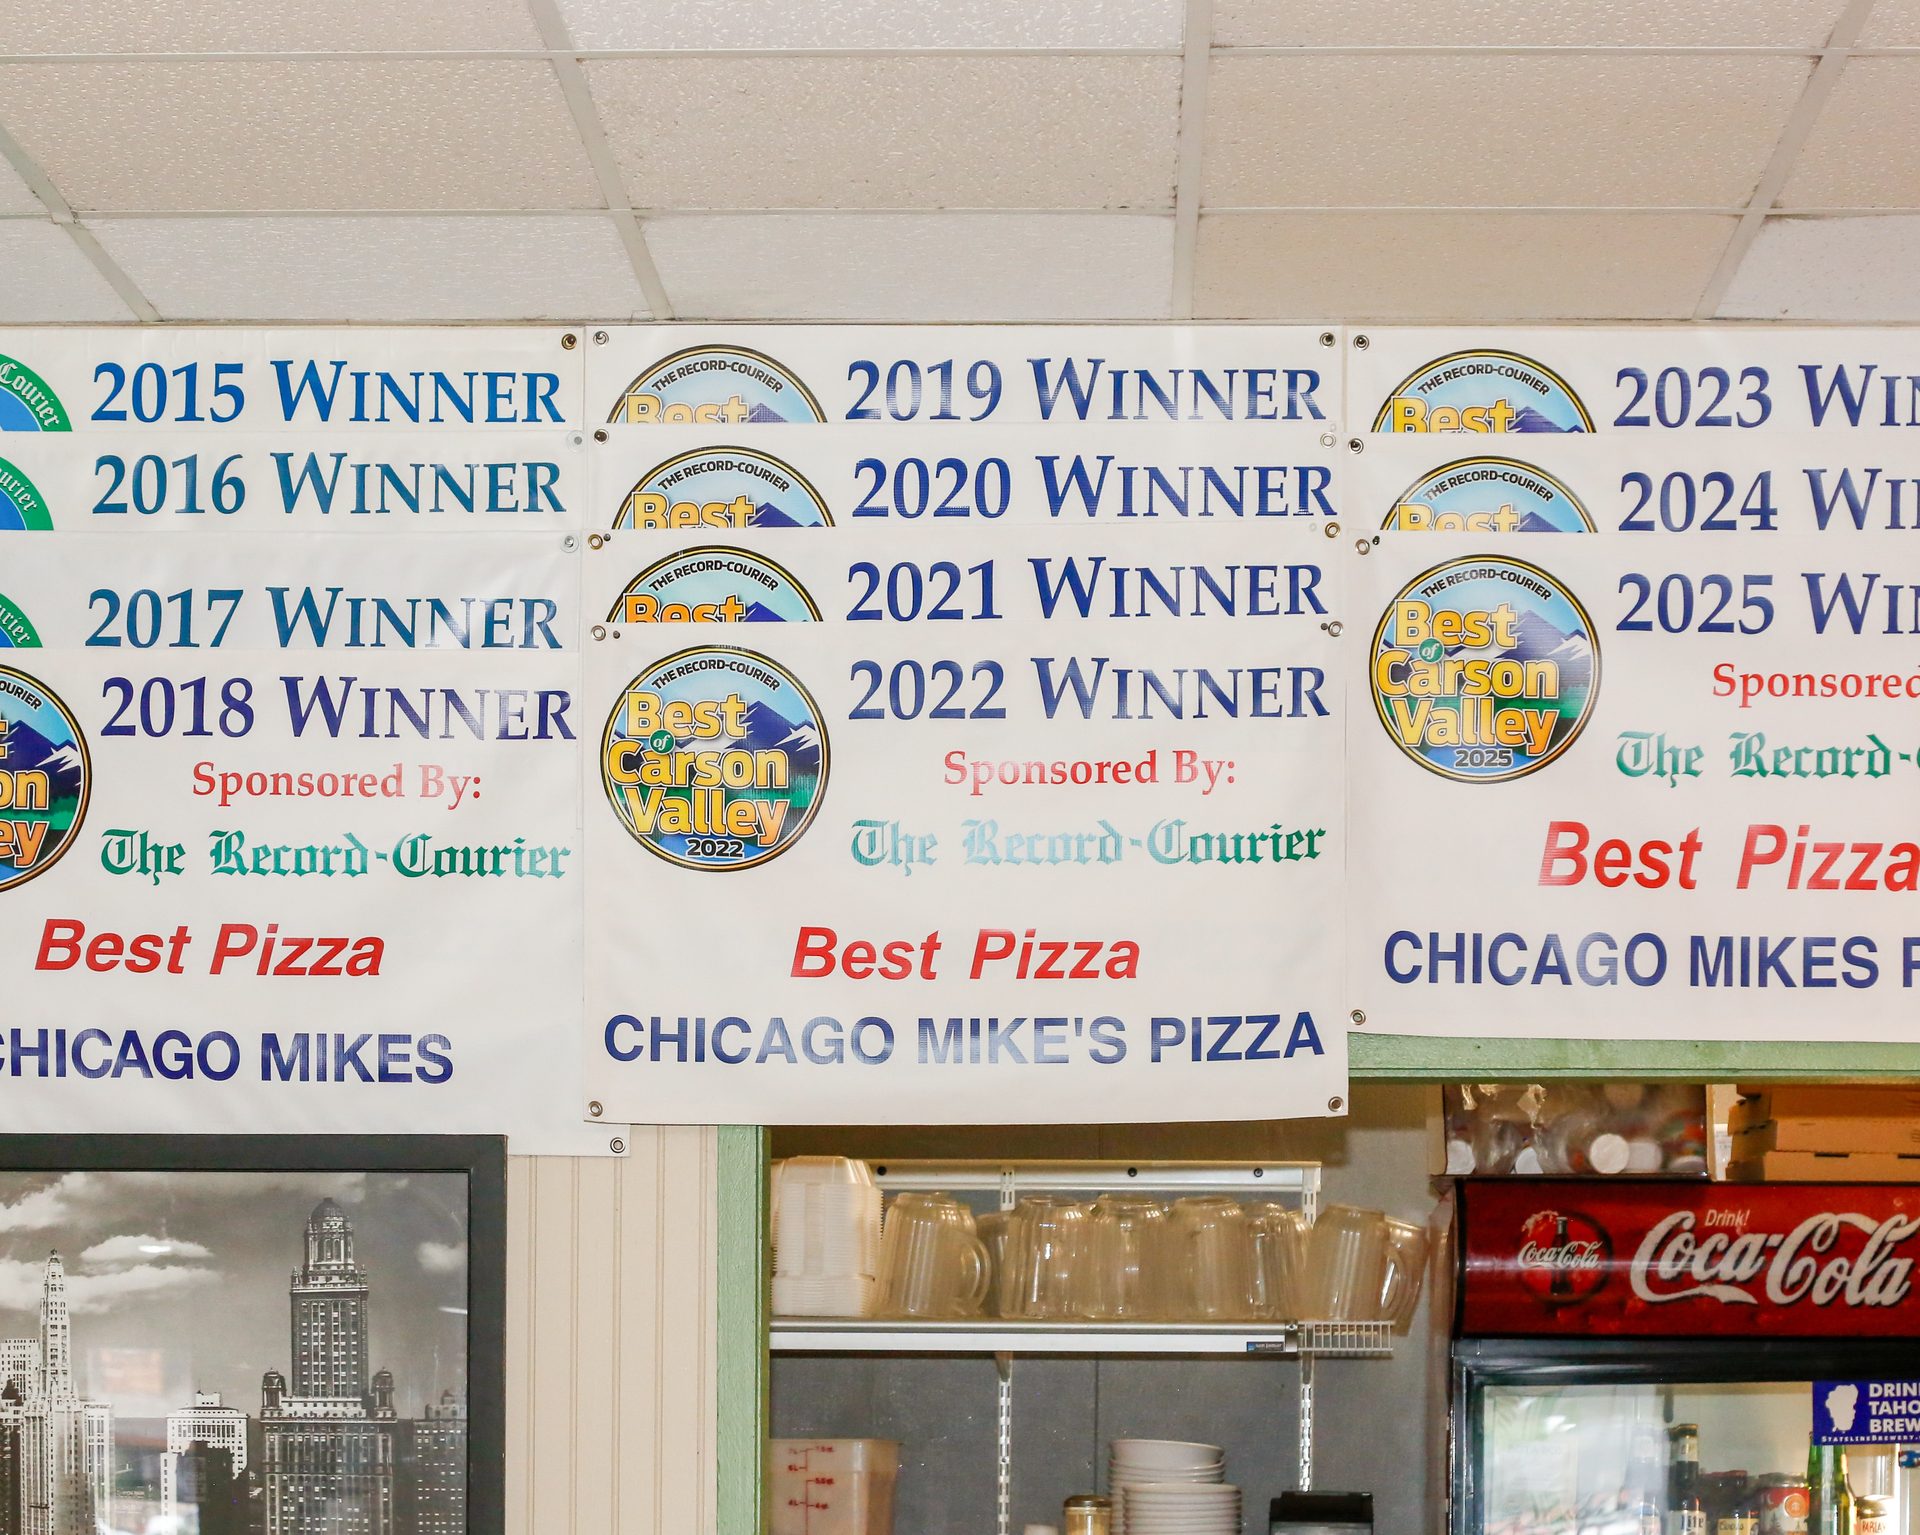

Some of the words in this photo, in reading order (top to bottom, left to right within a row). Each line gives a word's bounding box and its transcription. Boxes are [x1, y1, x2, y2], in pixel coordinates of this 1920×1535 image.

[91, 362, 245, 423] 2015
[270, 359, 566, 423] WINNER
[651, 371, 678, 392] THE
[678, 360, 784, 393] RECORD-COURIER
[845, 359, 1002, 421] 2019
[1027, 357, 1326, 420] WINNER
[1417, 374, 1444, 395] THE
[1443, 363, 1550, 396] RECORD-COURIER
[1613, 366, 1772, 428] 2023
[92, 454, 245, 515] 2016
[270, 452, 567, 514] WINNER
[657, 471, 684, 491] THE
[684, 460, 791, 493] RECORD-COURIER
[852, 458, 1011, 519] 2020
[1035, 455, 1338, 517] WINNER
[1422, 481, 1449, 501] THE
[1448, 470, 1554, 502] RECORD-COURIER
[1619, 471, 1778, 532] 2024
[1802, 468, 1920, 531] WI
[649, 572, 675, 592] THE
[673, 560, 779, 592] RECORD-COURIER
[846, 559, 1003, 621] 2021
[1027, 557, 1328, 619] WINNER
[1420, 579, 1447, 598] THE
[1445, 568, 1552, 601] RECORD-COURIER
[85, 588, 244, 648] 2017
[265, 586, 562, 649] WINNER
[1394, 600, 1517, 648] Best
[1616, 573, 1774, 635] 2025
[651, 670, 677, 690] THE
[676, 659, 781, 691] RECORD-COURIER
[1376, 649, 1559, 697] Carson
[1421, 643, 1440, 659] of
[101, 676, 254, 738] 2018
[279, 676, 576, 740] WINNER
[626, 691, 747, 738] Best
[849, 660, 1006, 720] 2022
[1030, 657, 1330, 720] WINNER
[652, 734, 672, 751] of
[1391, 698, 1558, 755] Valley
[607, 739, 788, 787] Carson
[945, 749, 1159, 795] Sponsored
[1172, 750, 1234, 795] By:
[1454, 749, 1513, 767] 2025
[1616, 731, 1704, 788] The
[1729, 732, 1920, 779] Record-
[193, 762, 405, 807] Sponsored
[419, 765, 480, 810] By:
[624, 788, 788, 846] Valley
[101, 829, 186, 886] The
[209, 830, 571, 879] Record-Courier
[686, 838, 744, 858] 2022
[851, 819, 937, 876] The
[964, 819, 1326, 865] Record-Courier
[1539, 821, 1703, 890] Best
[1736, 824, 1920, 892] Pizza
[35, 919, 192, 974] Best
[209, 924, 384, 976] Pizza
[791, 927, 942, 980] Best
[970, 929, 1140, 979] Pizza
[1384, 930, 1667, 987] CHICAGO
[1690, 936, 1879, 989] MIKES
[0, 1027, 240, 1081] HICAGO
[261, 1032, 453, 1084] MIKES
[605, 1014, 894, 1065] CHICAGO
[918, 1016, 1127, 1064] MIKE'S
[1151, 1011, 1325, 1063] PIZZA
[1704, 1209, 1751, 1226] Drink!
[1517, 1240, 1603, 1269] Coca-Cola
[1630, 1210, 1920, 1305] Coca-Cola
[1869, 1383, 1920, 1398] DRIN
